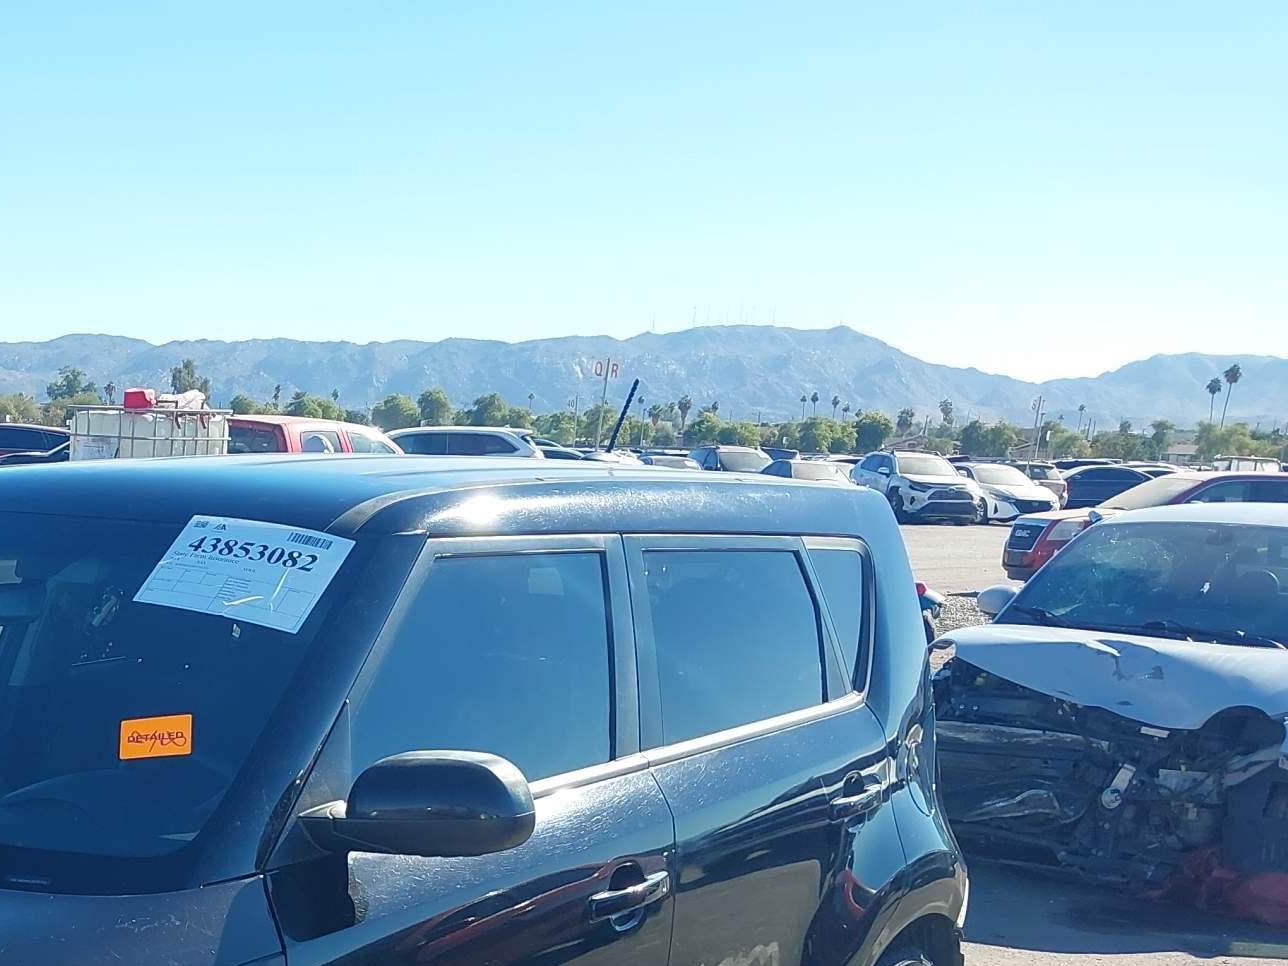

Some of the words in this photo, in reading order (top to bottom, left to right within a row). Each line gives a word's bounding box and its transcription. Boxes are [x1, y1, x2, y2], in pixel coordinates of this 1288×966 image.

[611, 363, 619, 379] R
[188, 535, 319, 572] 43853082
[127, 731, 184, 744] DETAILED
